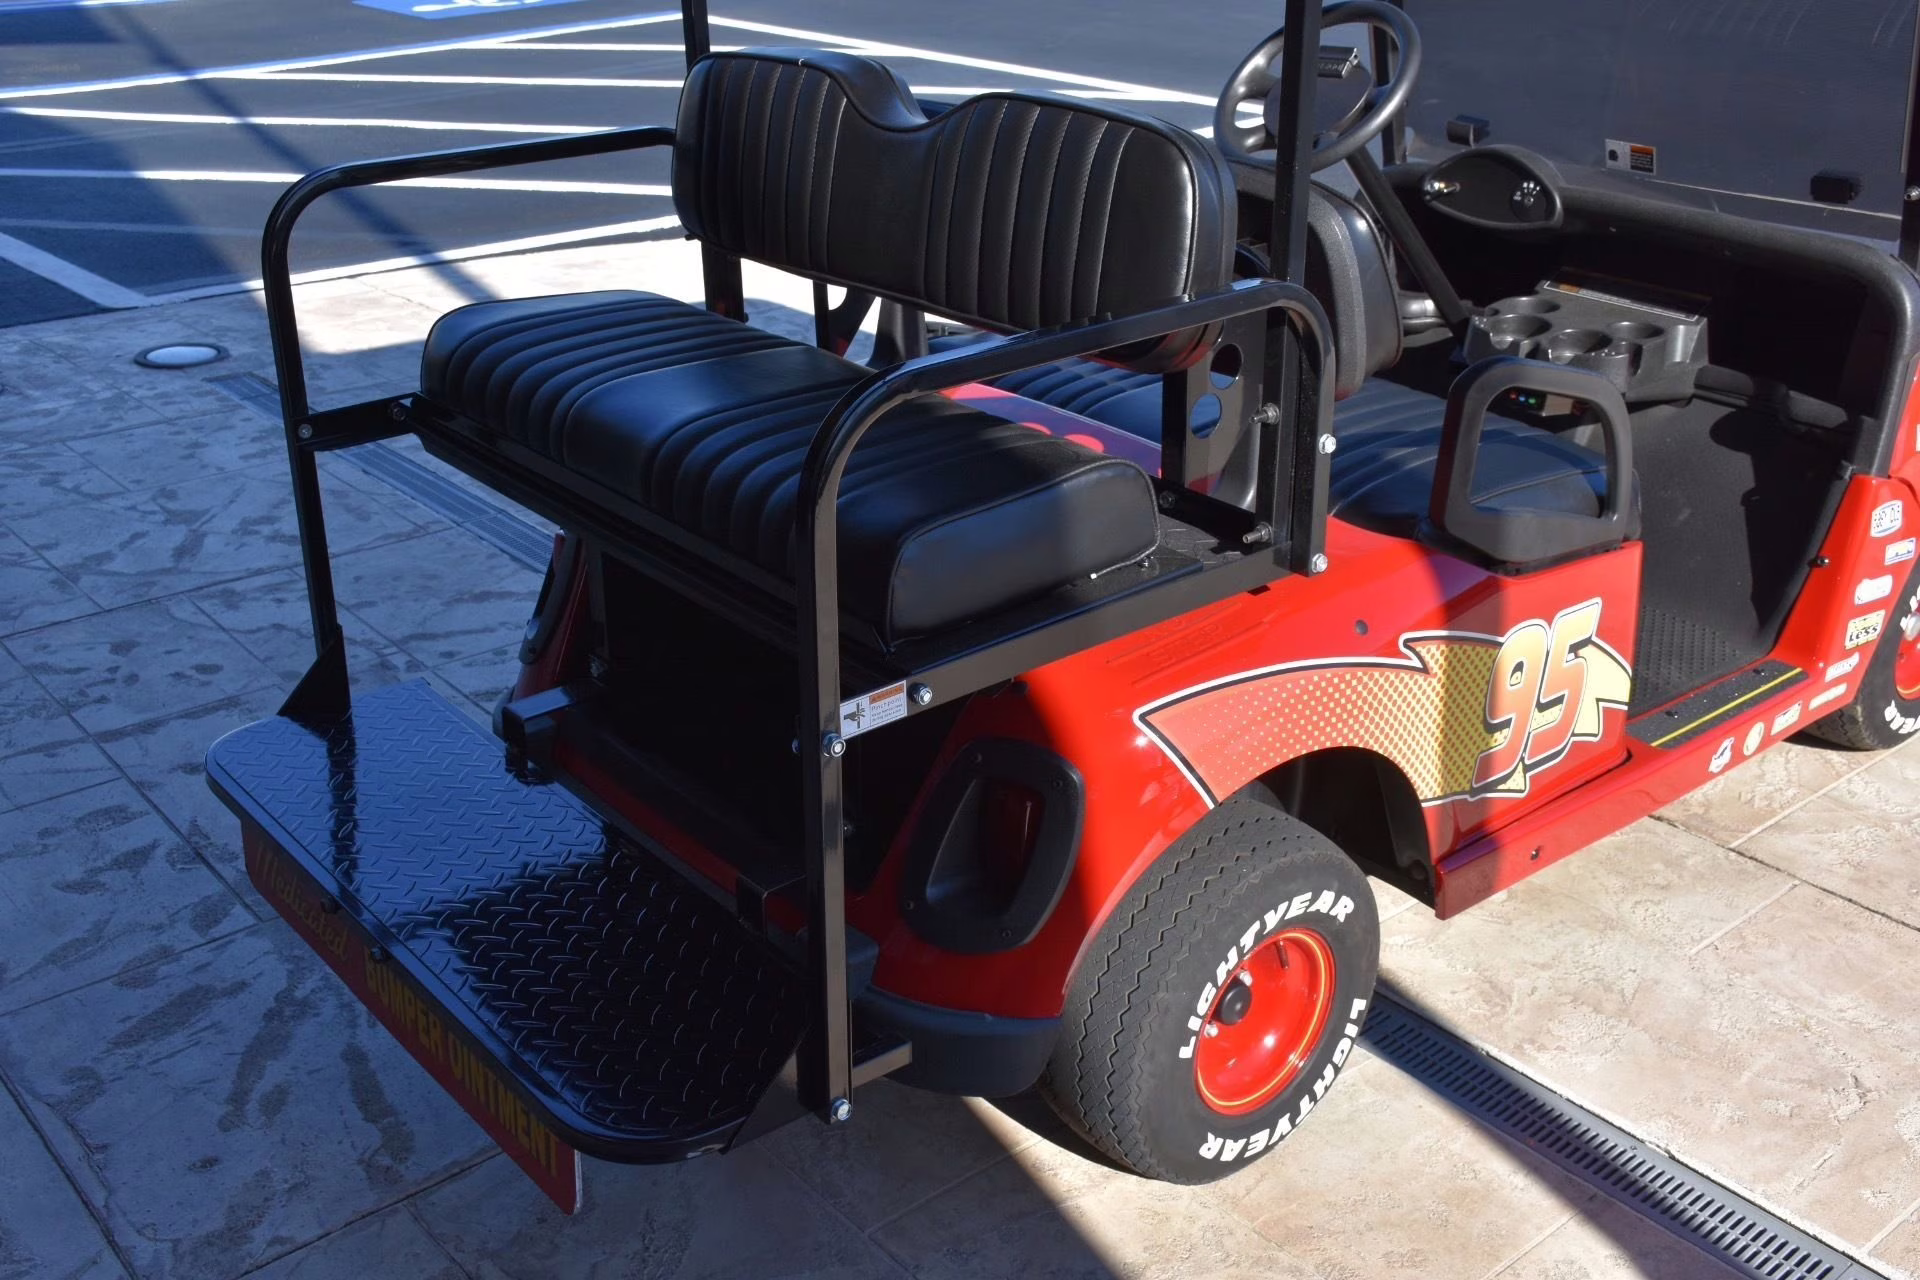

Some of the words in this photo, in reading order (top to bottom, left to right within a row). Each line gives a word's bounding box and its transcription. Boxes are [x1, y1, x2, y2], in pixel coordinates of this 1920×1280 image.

[1472, 597, 1602, 788] 95
[1179, 890, 1355, 1059] LIGHTYEAR
[448, 1030, 561, 1178] OINTMENT
[1199, 998, 1367, 1162] LIGHTYEAR
